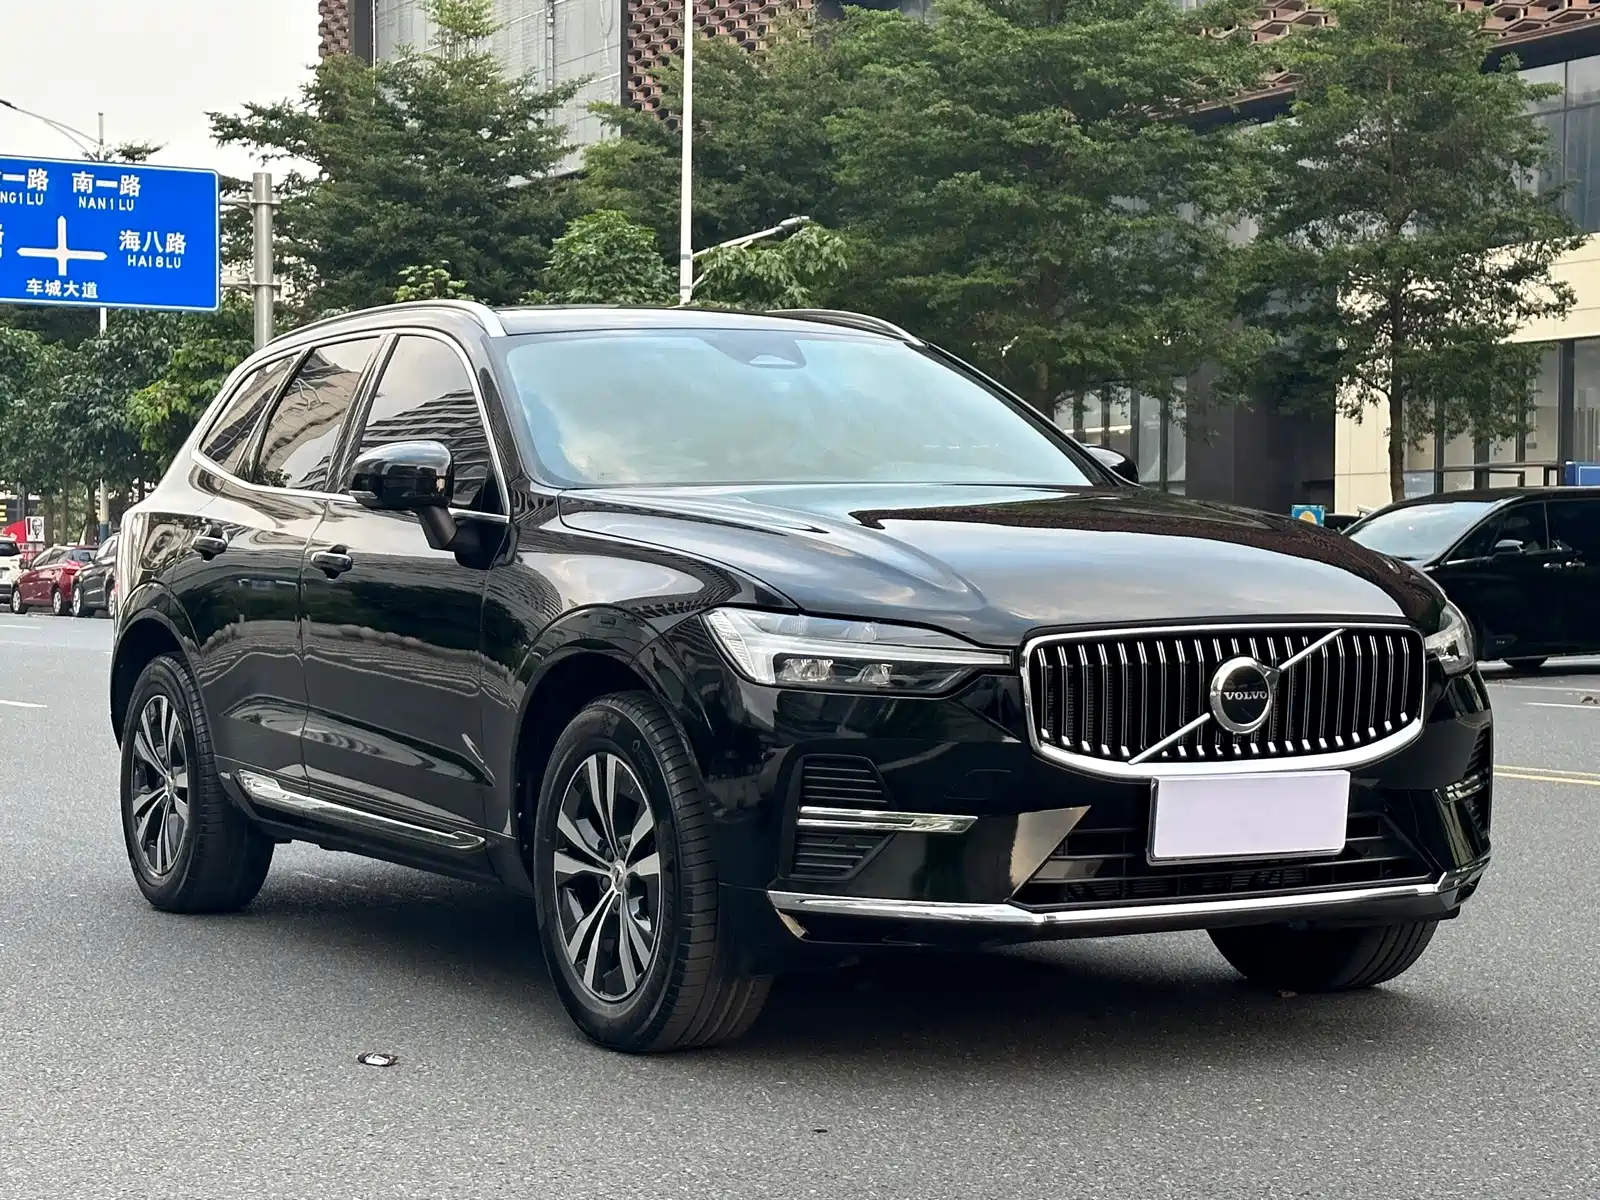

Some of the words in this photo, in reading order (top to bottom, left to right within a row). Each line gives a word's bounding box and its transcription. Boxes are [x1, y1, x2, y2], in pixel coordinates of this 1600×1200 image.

[0, 168, 49, 192] 一路
[72, 171, 141, 198] 南一路
[119, 230, 187, 255] 海八路
[26, 278, 99, 299] 车城大道
[1223, 691, 1268, 700] VOLVO
